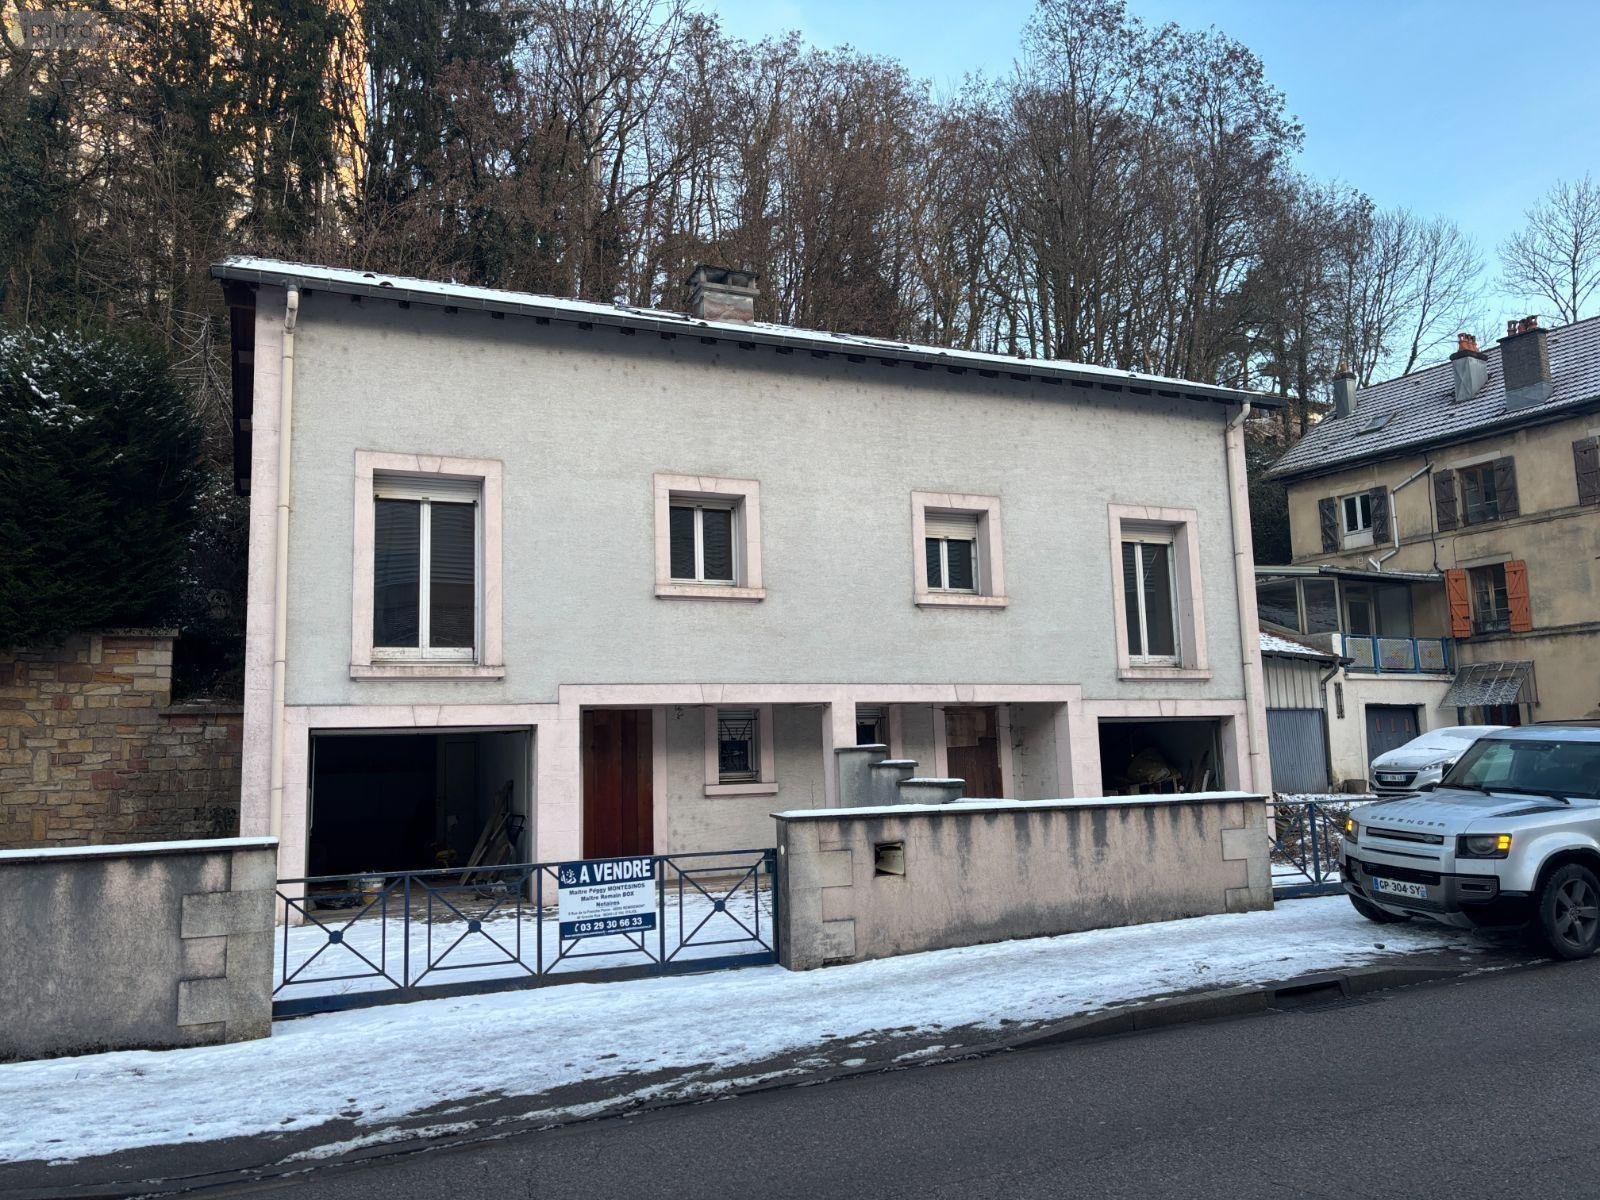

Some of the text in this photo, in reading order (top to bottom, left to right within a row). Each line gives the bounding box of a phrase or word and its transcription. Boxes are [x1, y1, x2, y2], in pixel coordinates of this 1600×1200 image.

[1371, 816, 1446, 827] DEFENDER
[580, 859, 651, 883] A VENDRE
[1391, 882, 1408, 893] 304
[580, 923, 591, 932] 03
[593, 921, 604, 931] 29
[606, 920, 617, 929] 30
[620, 918, 630, 927] 66
[632, 917, 643, 926] 33
